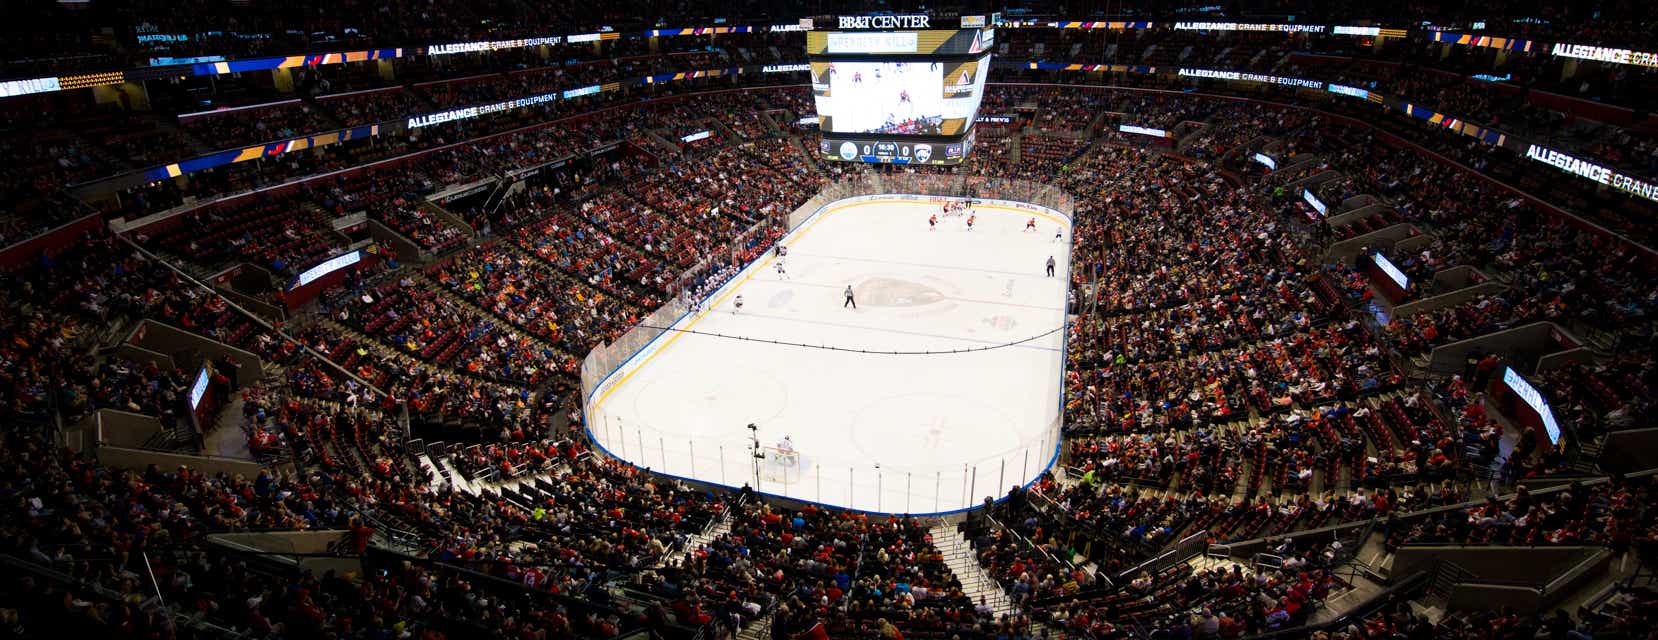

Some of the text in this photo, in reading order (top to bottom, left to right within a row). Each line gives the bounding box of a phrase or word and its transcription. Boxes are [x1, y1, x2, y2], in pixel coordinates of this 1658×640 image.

[838, 15, 930, 28] BB&T CENTER
[1174, 22, 1236, 31] ALLEGIANCE
[1238, 23, 1267, 31] CRANE
[1278, 24, 1325, 33] EQUIPMENT
[428, 42, 490, 55] ALLEGIANCE
[491, 40, 515, 49] CRANE
[517, 39, 523, 47] &
[524, 36, 561, 47] EQUIPMENT
[1552, 43, 1631, 64] ALLEGIANCE
[1178, 68, 1323, 89] ALLEGIANCE CRANE & EQUIPMENT
[408, 93, 557, 129] ALLEGIANCE CRANE & EQUIPMENT
[864, 145, 870, 155] 0
[903, 146, 909, 156] 0
[1526, 144, 1612, 184] ALLEGIANCE
